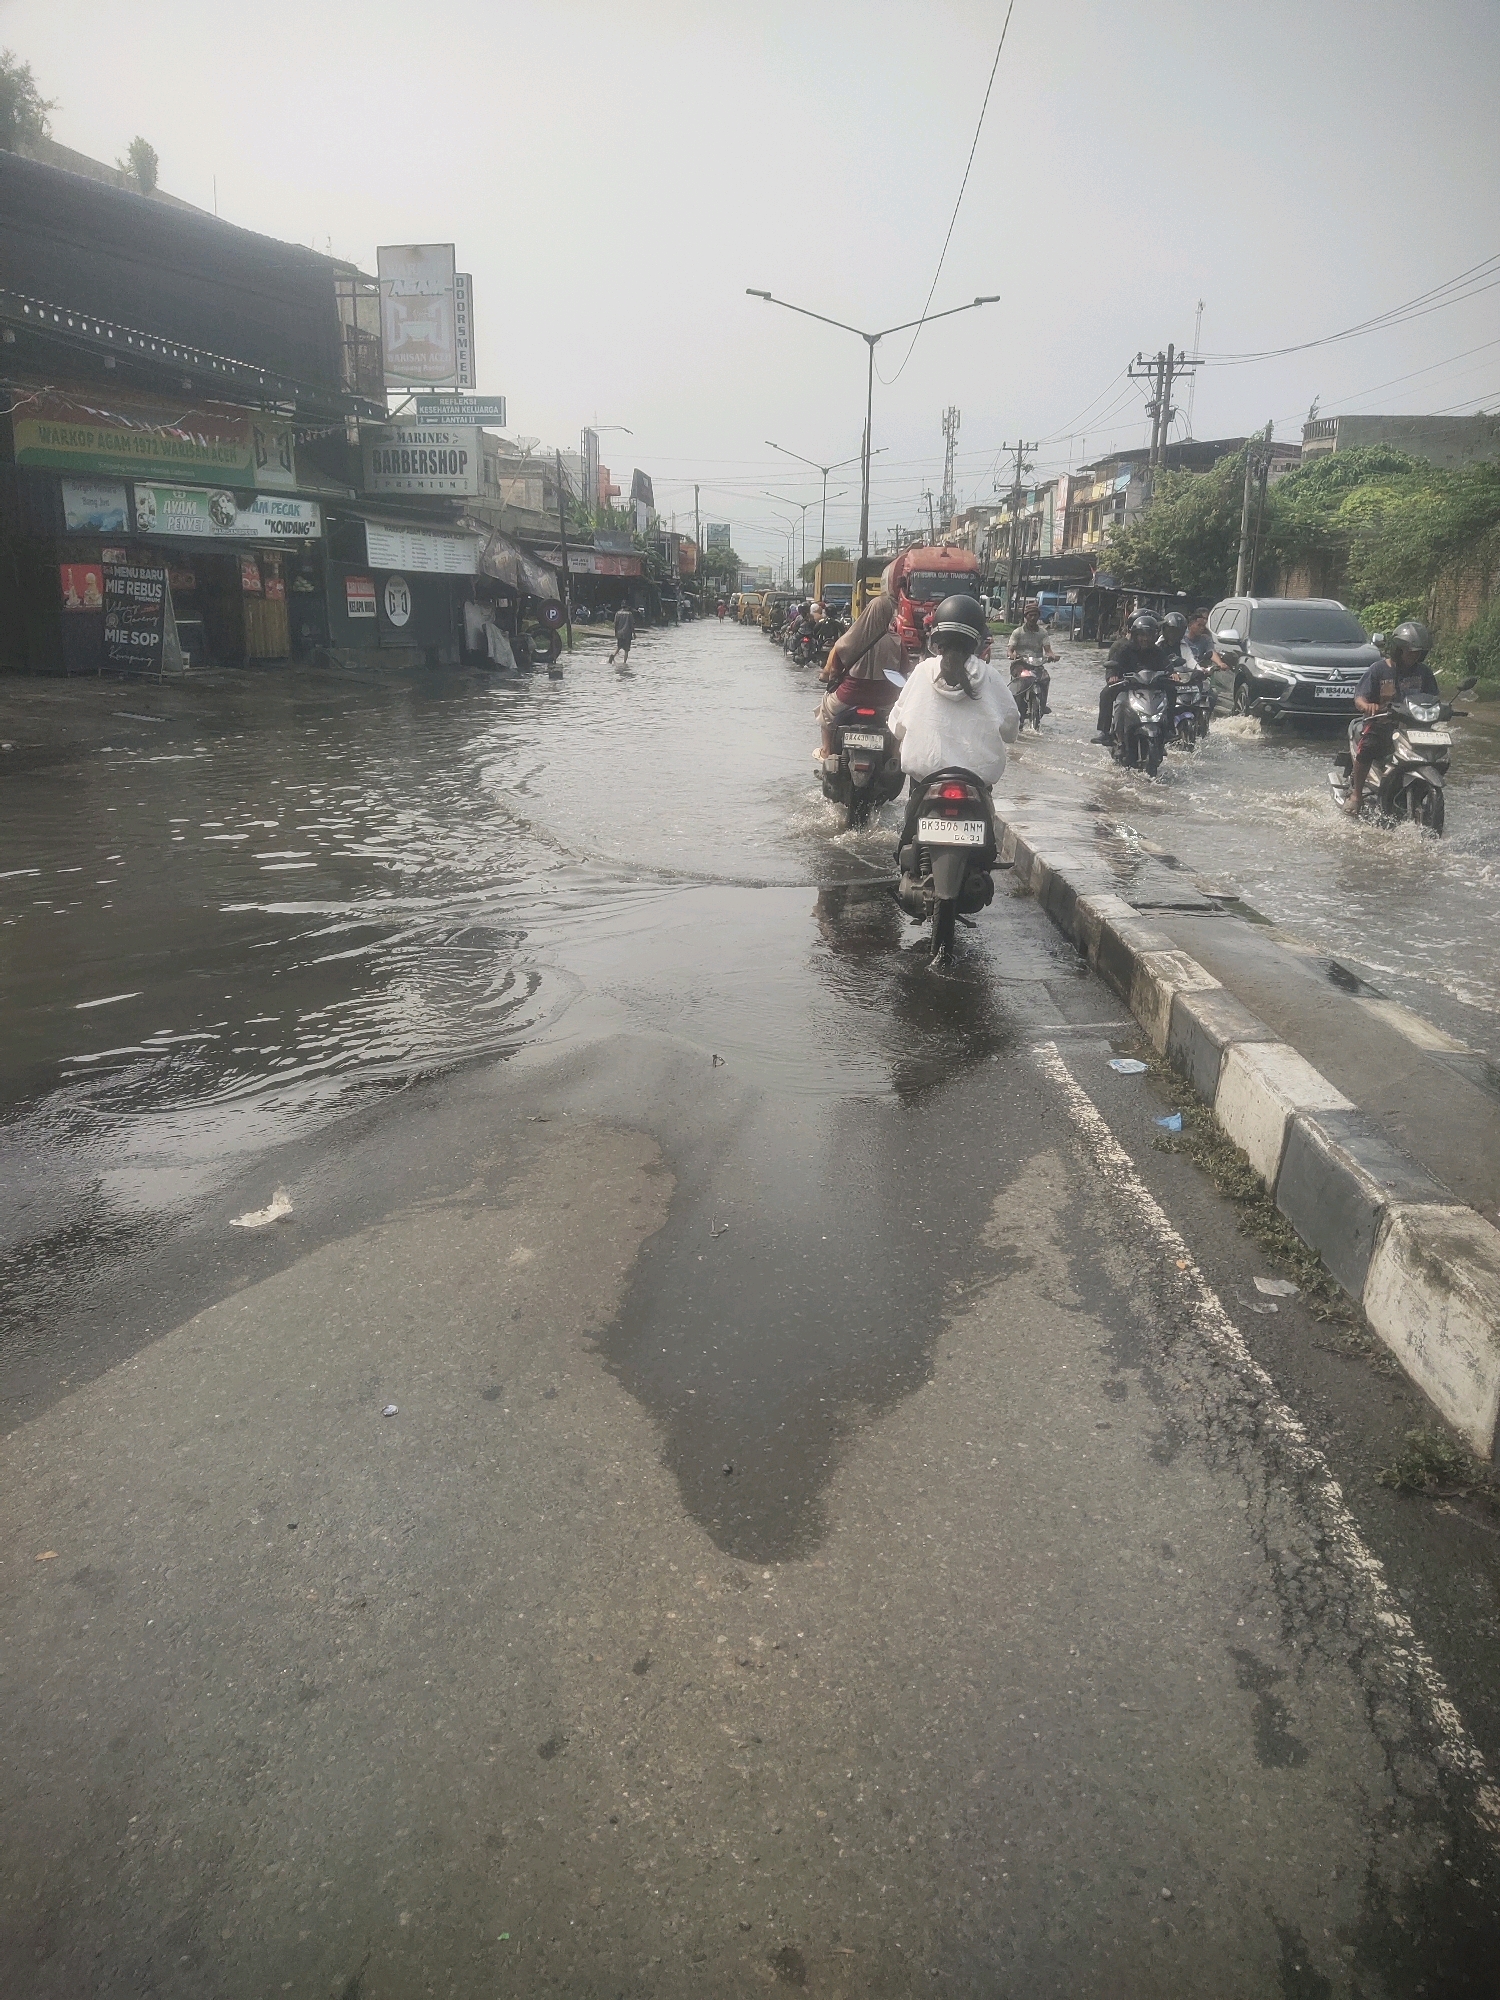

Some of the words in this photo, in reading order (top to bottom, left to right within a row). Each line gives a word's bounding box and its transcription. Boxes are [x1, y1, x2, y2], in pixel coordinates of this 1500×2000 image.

[456, 277, 468, 384] DOORSMEER
[387, 353, 427, 362] WARISAN
[419, 405, 460, 414] KESEHATAN
[462, 405, 499, 414] KELUARGA
[441, 416, 468, 424] LANTAI
[38, 426, 94, 448] WARKOP
[98, 432, 131, 453] AGAM
[134, 435, 159, 455] 1972
[160, 438, 209, 461] WARISAN
[211, 445, 237, 463] ACEH
[396, 432, 449, 444] MARINES
[372, 449, 468, 475] BARBERSHOP
[385, 480, 457, 489] PREMIUM
[162, 500, 197, 515] AYAM
[271, 501, 301, 516] PECAK
[167, 515, 205, 532] PENYET
[114, 566, 138, 578] MENU
[139, 567, 164, 580] BARU
[105, 579, 125, 594] MIE
[126, 581, 163, 598] REBUS
[549, 609, 557, 619] P
[104, 628, 128, 644] MIE
[130, 631, 159, 646] SOP
[963, 822, 983, 833] ANM
